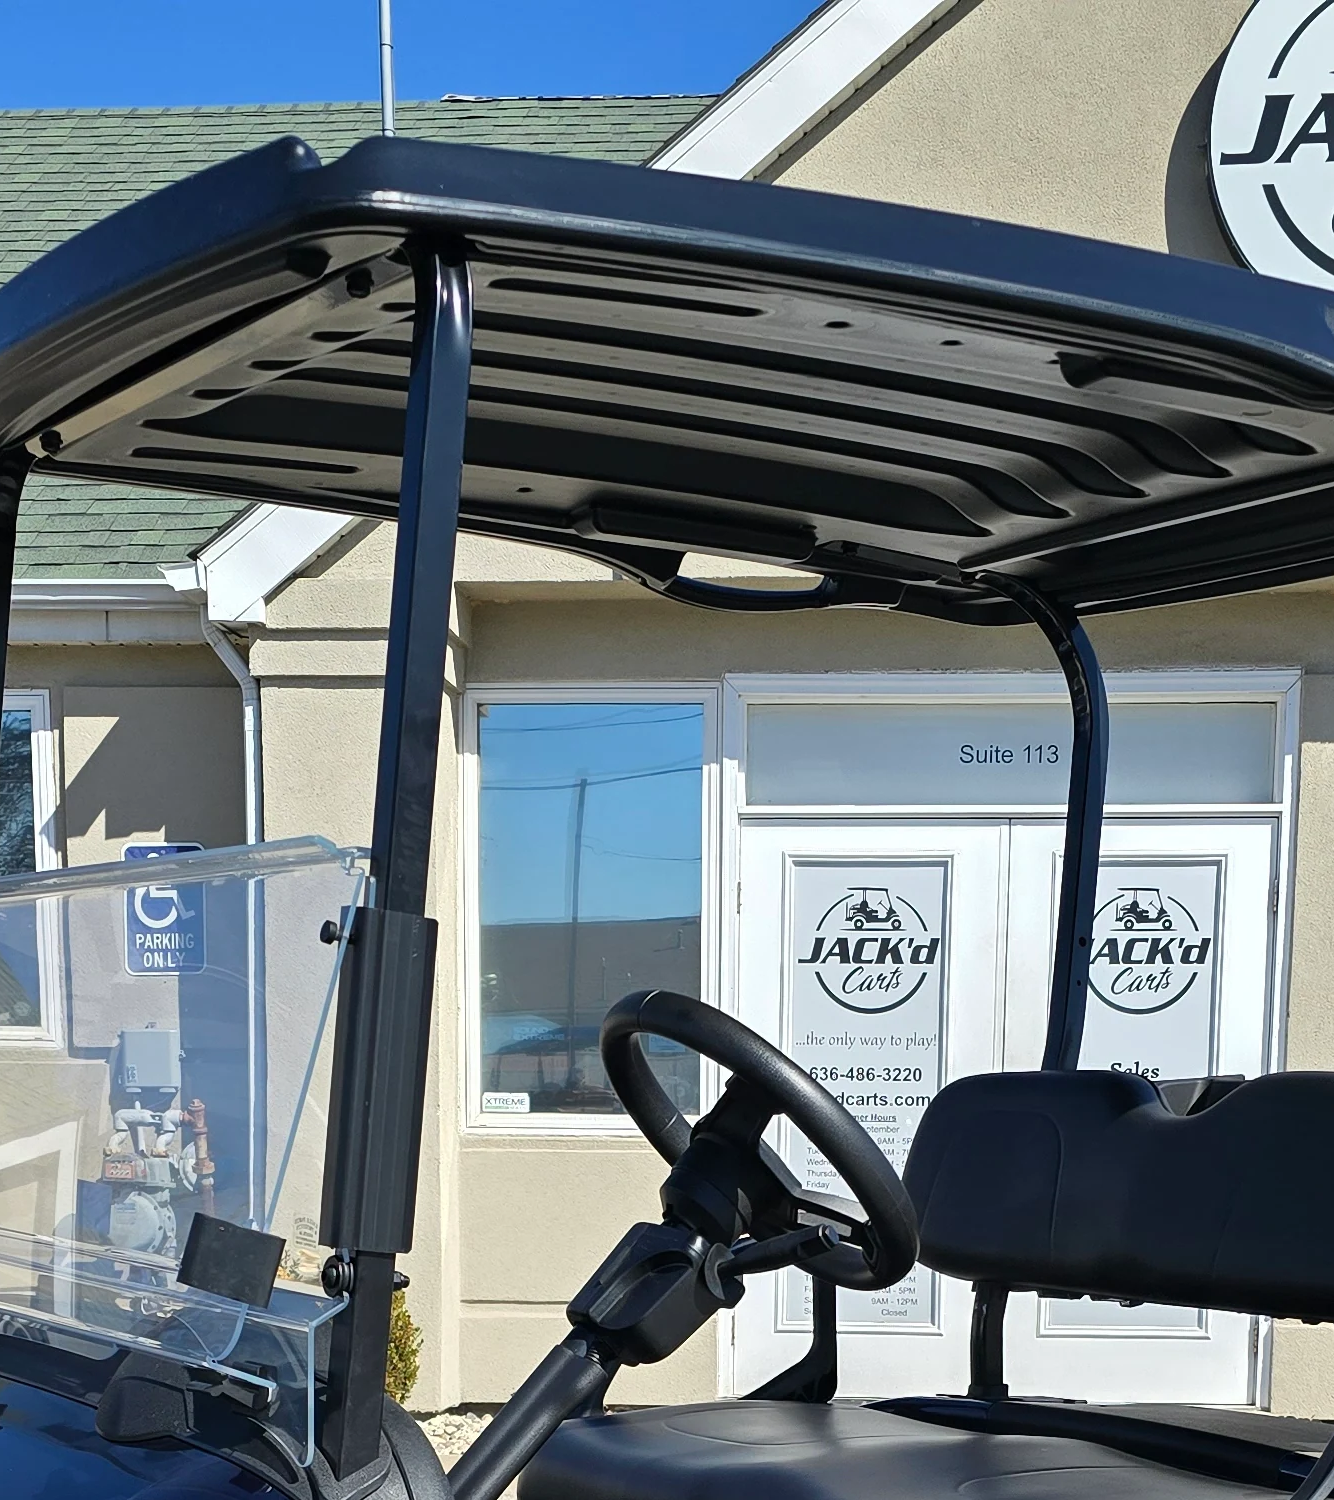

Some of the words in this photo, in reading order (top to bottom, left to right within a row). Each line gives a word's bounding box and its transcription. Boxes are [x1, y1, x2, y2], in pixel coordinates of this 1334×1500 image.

[960, 744, 1014, 763] Suite
[1023, 744, 1059, 763] 113
[136, 933, 195, 949] PARKING
[143, 951, 186, 967] ONLY
[798, 937, 940, 964] JACK'd
[1089, 937, 1212, 964] ACK'd
[842, 965, 904, 994] Carts
[1110, 966, 1174, 995] Carts
[828, 1031, 856, 1050] only
[859, 1036, 887, 1050] way
[890, 1034, 902, 1047] to
[905, 1032, 937, 1051] play!
[809, 1067, 922, 1082] 636-486-3220
[835, 1091, 930, 1106] dcarts.com
[806, 1181, 830, 1189] Friday
[881, 1309, 908, 1317] Closed
